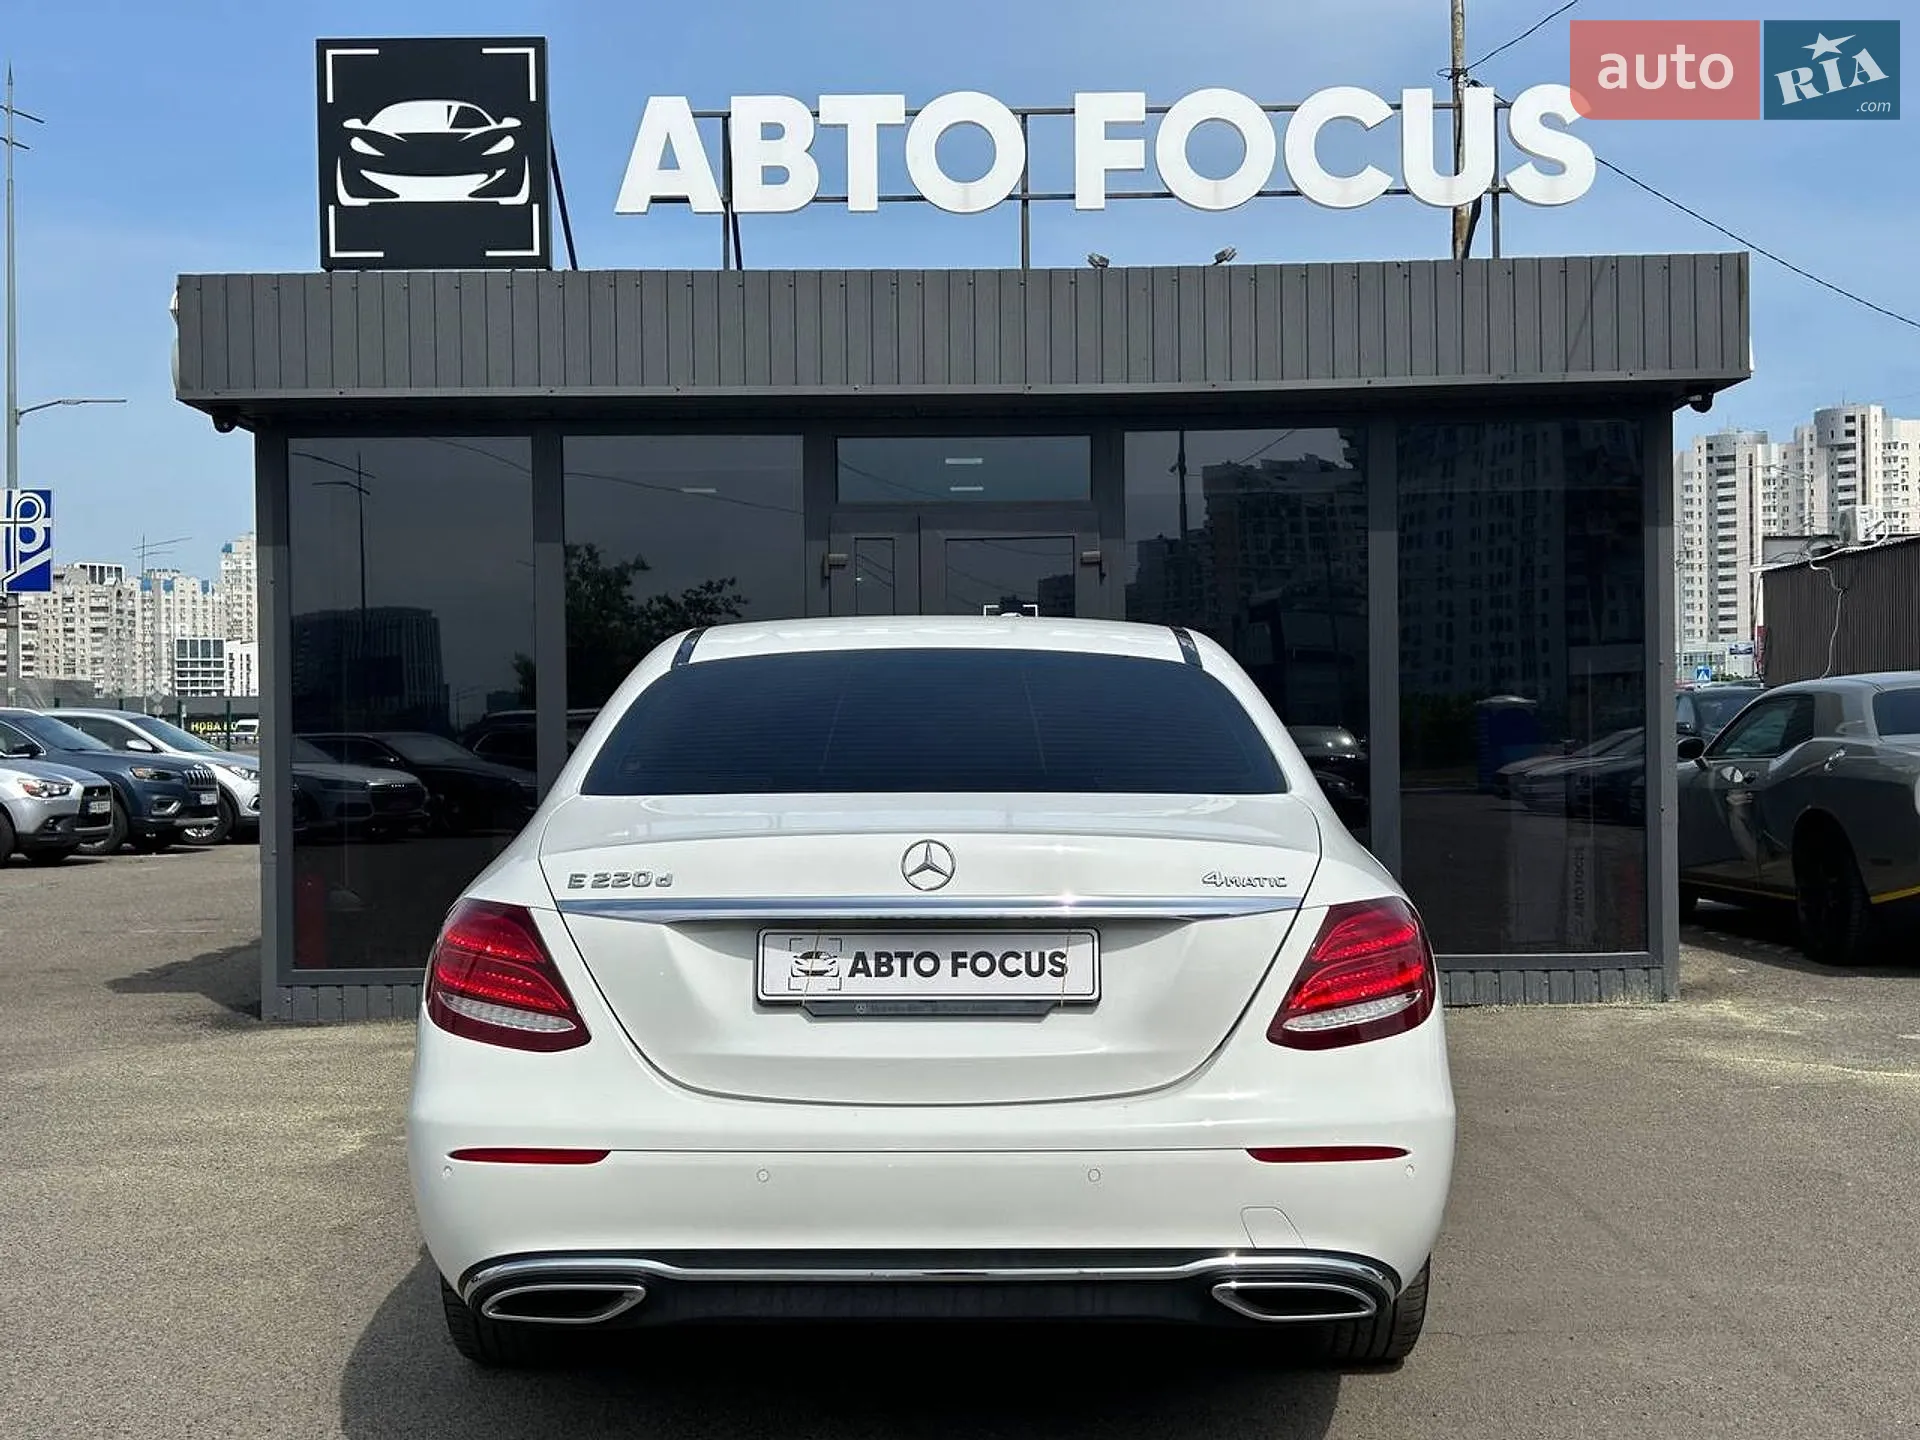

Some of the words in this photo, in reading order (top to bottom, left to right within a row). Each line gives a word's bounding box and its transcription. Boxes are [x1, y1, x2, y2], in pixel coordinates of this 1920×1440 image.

[614, 91, 1026, 213] АВТО
[1075, 84, 1596, 211] FOCUS
[848, 951, 941, 978] АВТО
[951, 951, 1068, 978] FOCUS
